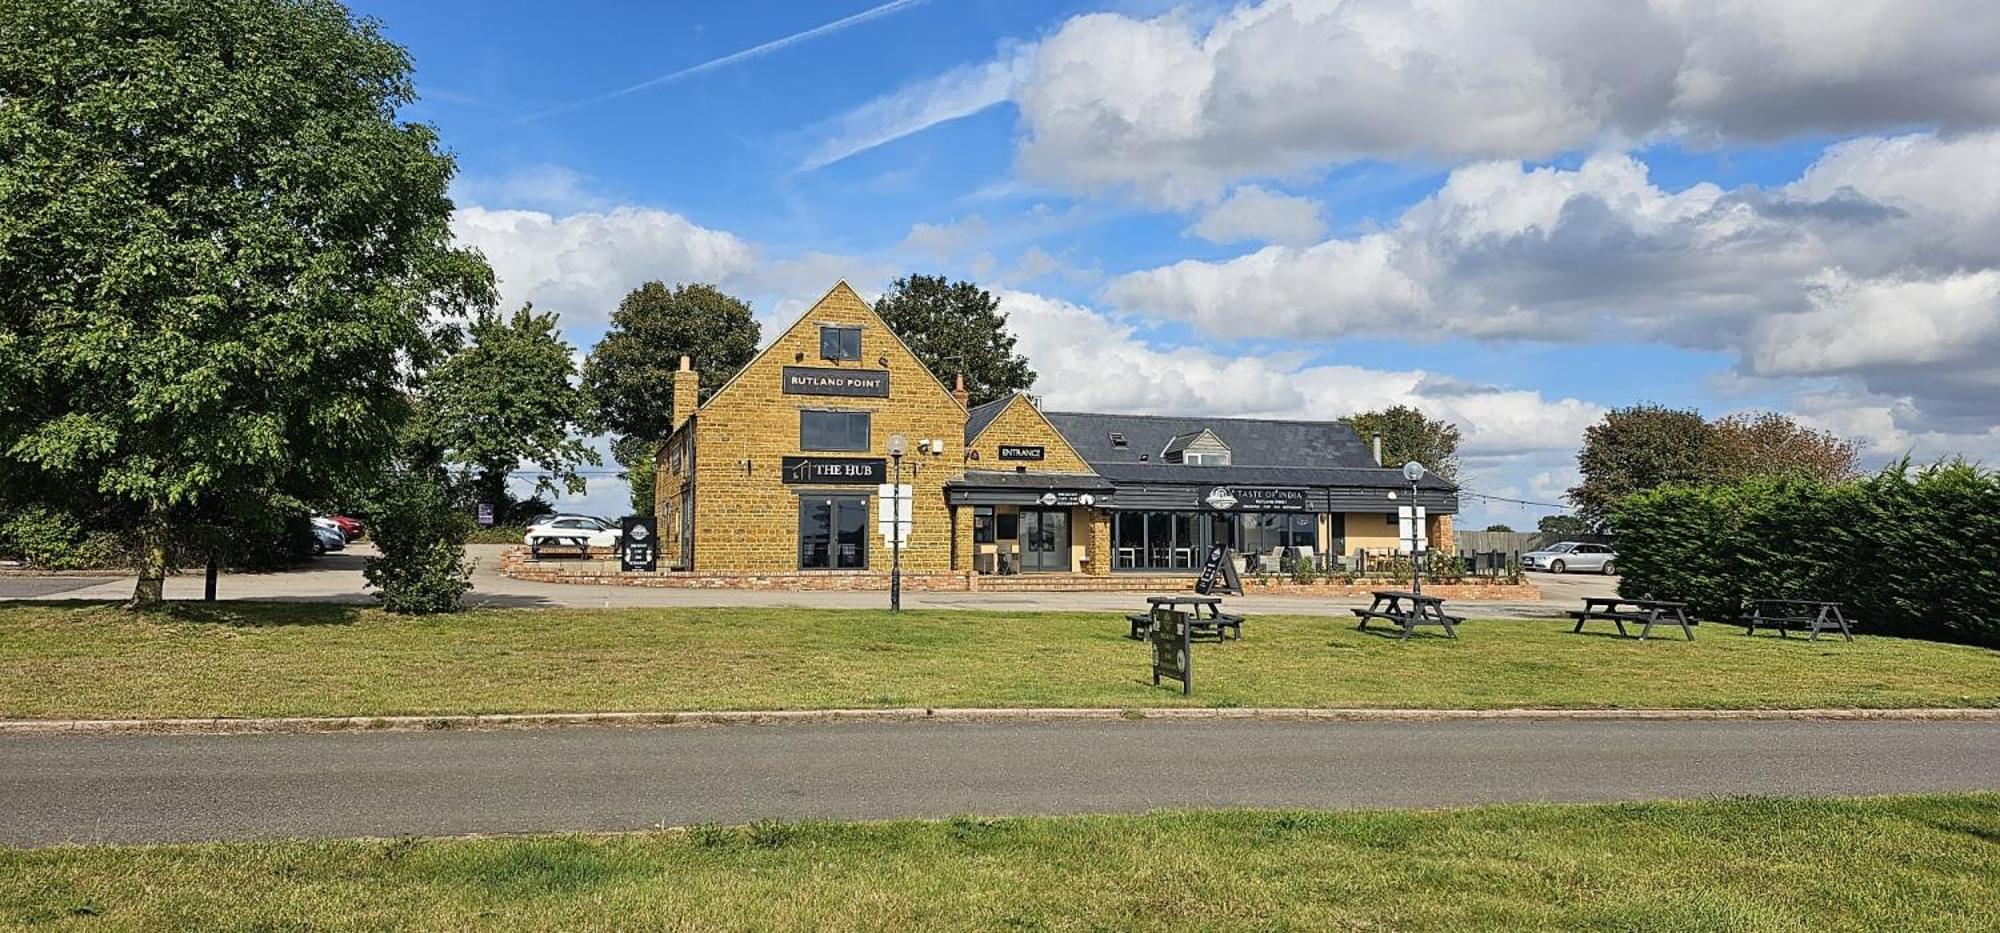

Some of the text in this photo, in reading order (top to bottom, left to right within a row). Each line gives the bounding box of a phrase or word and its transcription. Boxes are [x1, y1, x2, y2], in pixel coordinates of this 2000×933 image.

[791, 376, 881, 387] RUTLAND POINT
[1002, 448, 1041, 457] ENTRANCE
[815, 464, 873, 476] THE HUB
[1238, 490, 1303, 499] TASTE OF INDIA
